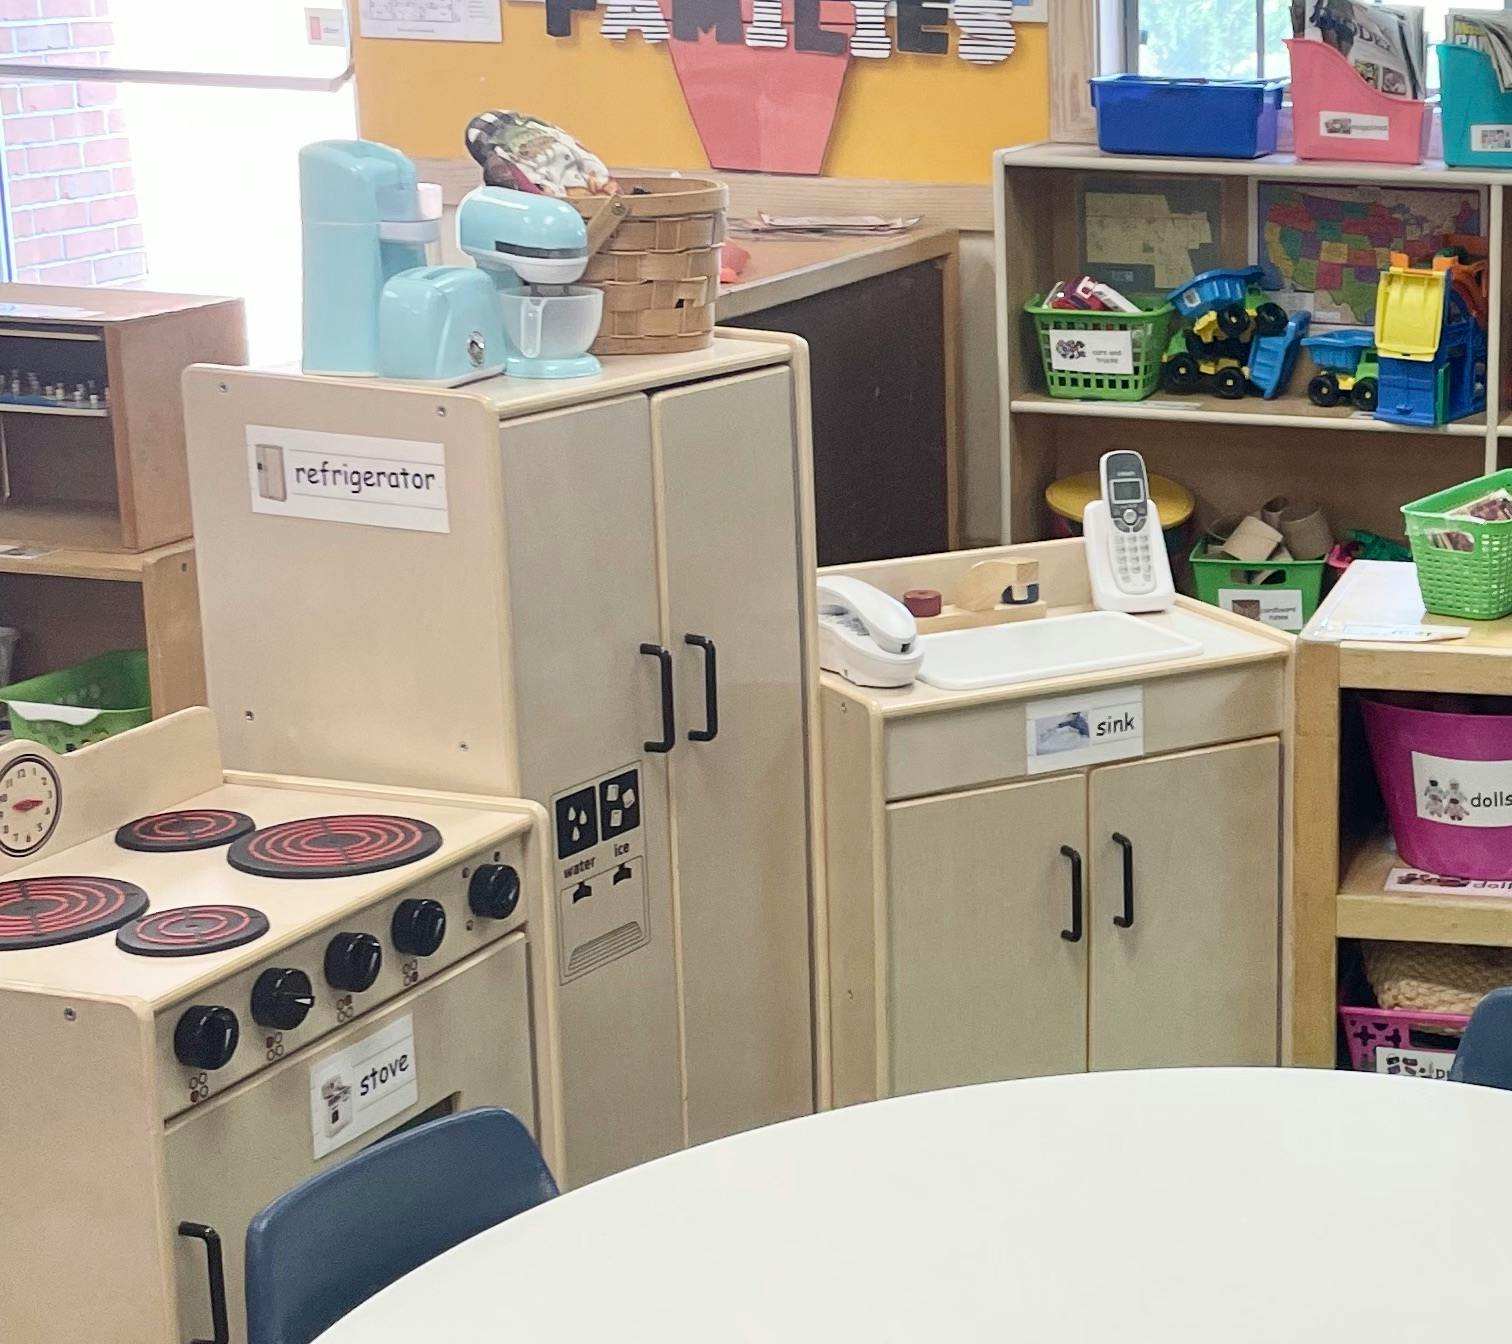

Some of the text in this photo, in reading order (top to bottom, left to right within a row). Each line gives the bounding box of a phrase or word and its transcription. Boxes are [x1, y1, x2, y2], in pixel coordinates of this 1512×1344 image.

[294, 460, 435, 493] refrigerator
[1096, 712, 1135, 737] sink
[614, 843, 629, 857] ice
[563, 856, 596, 878] water
[360, 1054, 409, 1096] stove
